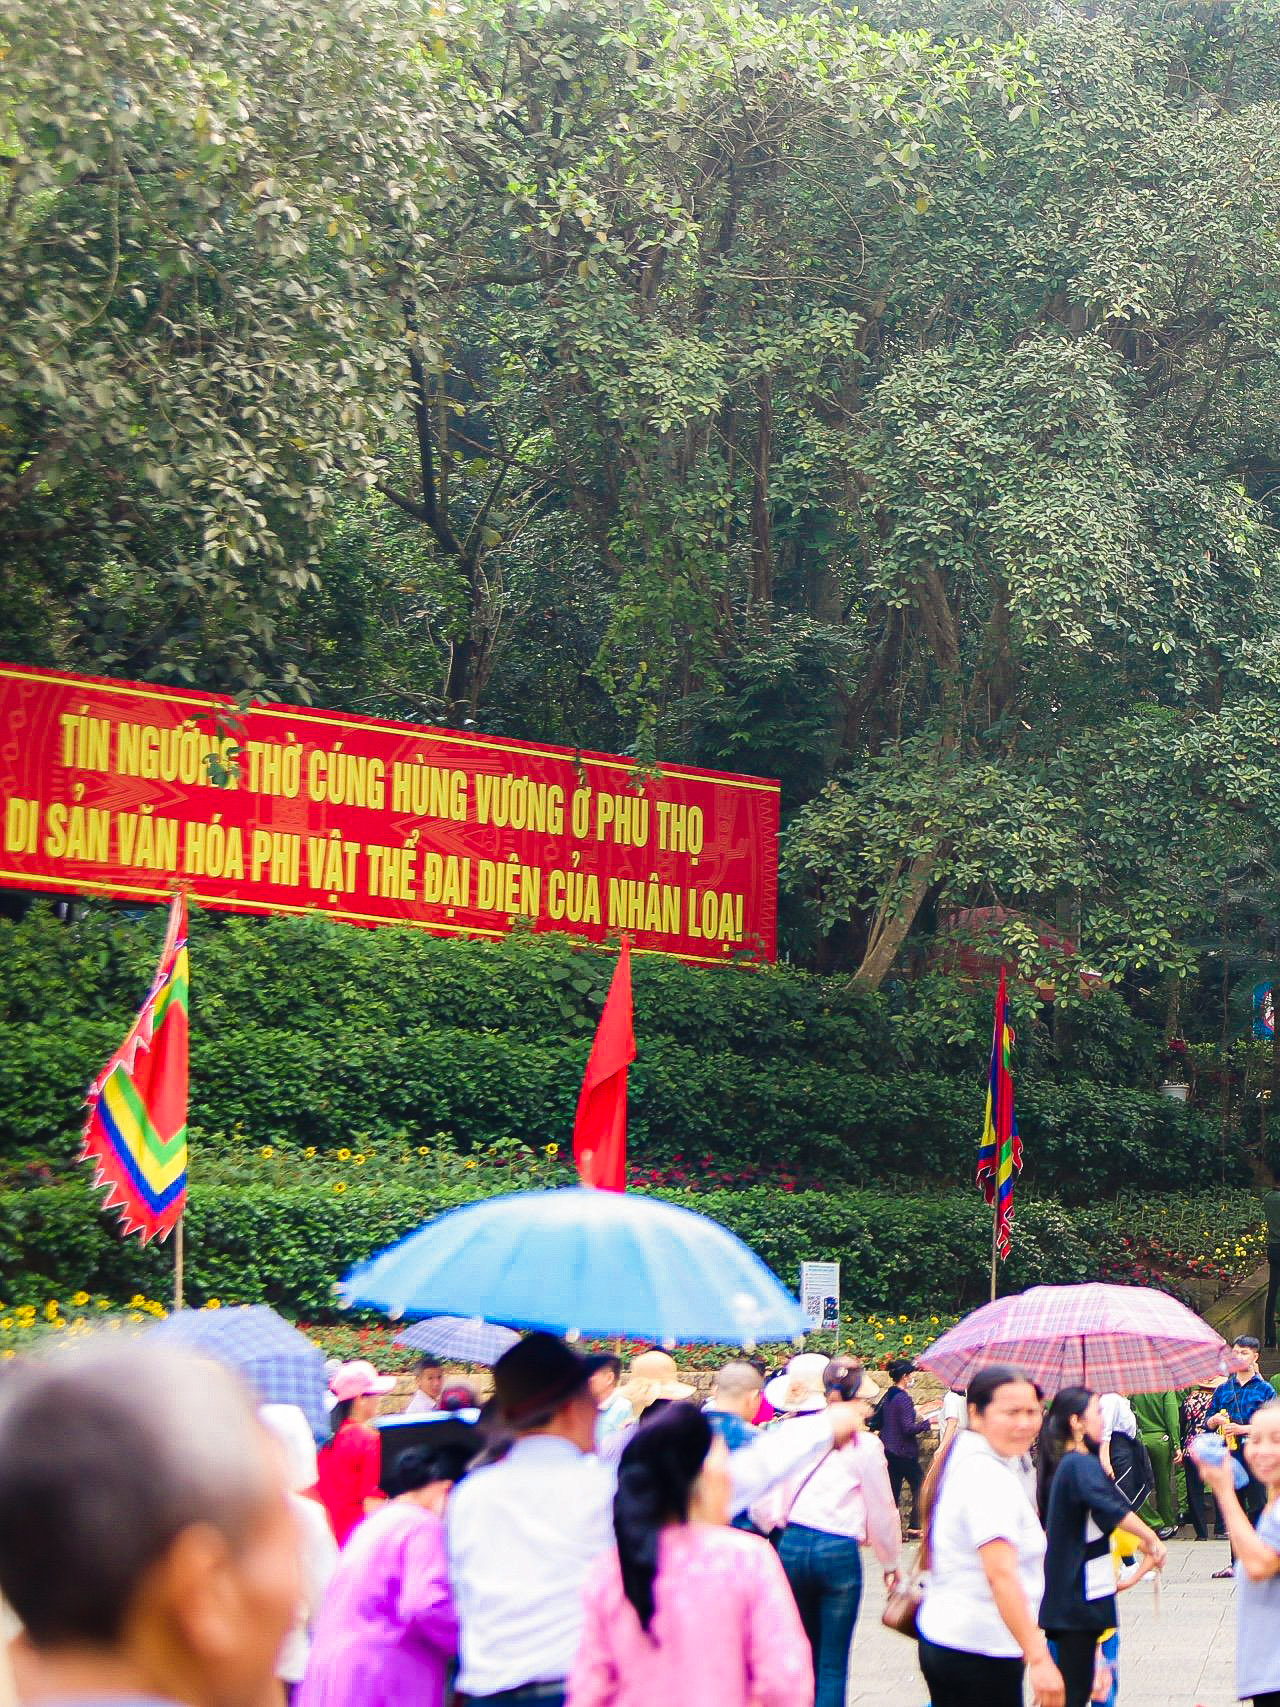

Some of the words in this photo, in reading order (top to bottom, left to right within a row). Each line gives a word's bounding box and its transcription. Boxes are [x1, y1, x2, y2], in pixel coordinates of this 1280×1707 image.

[61, 705, 110, 771] TÍN
[247, 732, 303, 798] THỜ
[309, 742, 385, 810] CÚNG
[392, 753, 467, 821] HÙNG
[475, 773, 564, 835] VƯƠNG
[572, 768, 592, 839] Ở
[597, 787, 649, 847] PHÚ
[656, 801, 704, 865] THỌ
[6, 797, 40, 854] DI
[45, 783, 110, 863] SẢN
[117, 804, 178, 871] VĂN
[185, 814, 245, 880] HÓA
[251, 830, 300, 886] PHI
[308, 829, 360, 903] VẬT
[366, 828, 419, 901] THỂ
[424, 852, 470, 917] ĐẠI
[478, 852, 541, 924] DIỆN
[548, 850, 600, 925] CỦA
[607, 872, 680, 935] NHÂN
[688, 888, 743, 952] LOẠI
